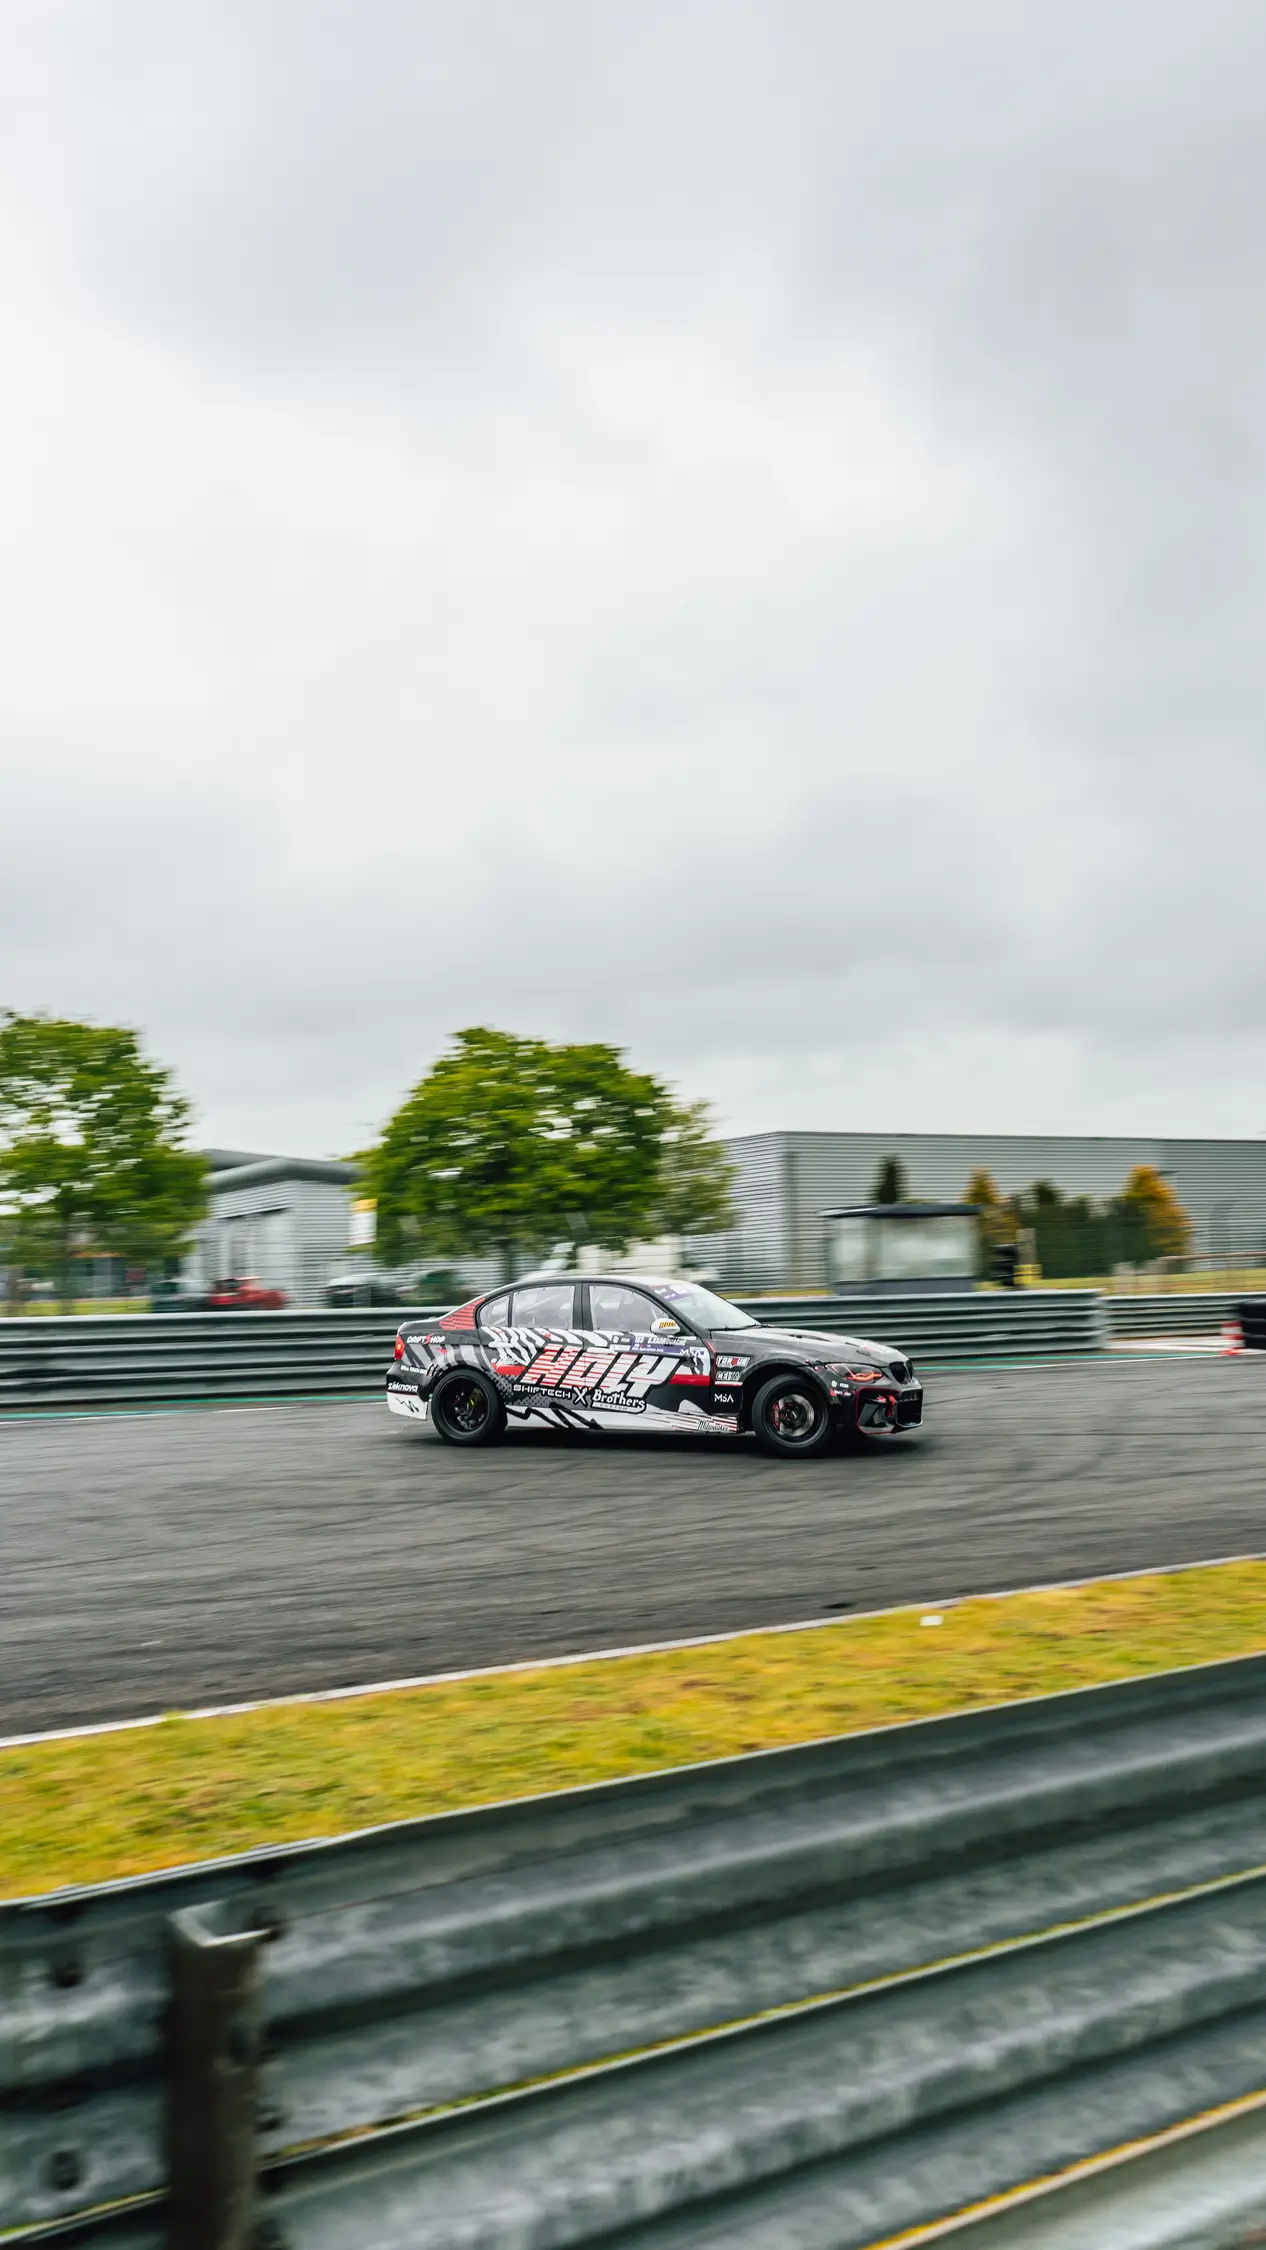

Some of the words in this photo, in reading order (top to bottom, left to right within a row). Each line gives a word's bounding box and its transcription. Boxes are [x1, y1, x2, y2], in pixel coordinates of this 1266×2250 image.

[520, 1344, 681, 1398] HOLY
[513, 1384, 571, 1399] SHIFTECH
[592, 1388, 646, 1411] Brothers
